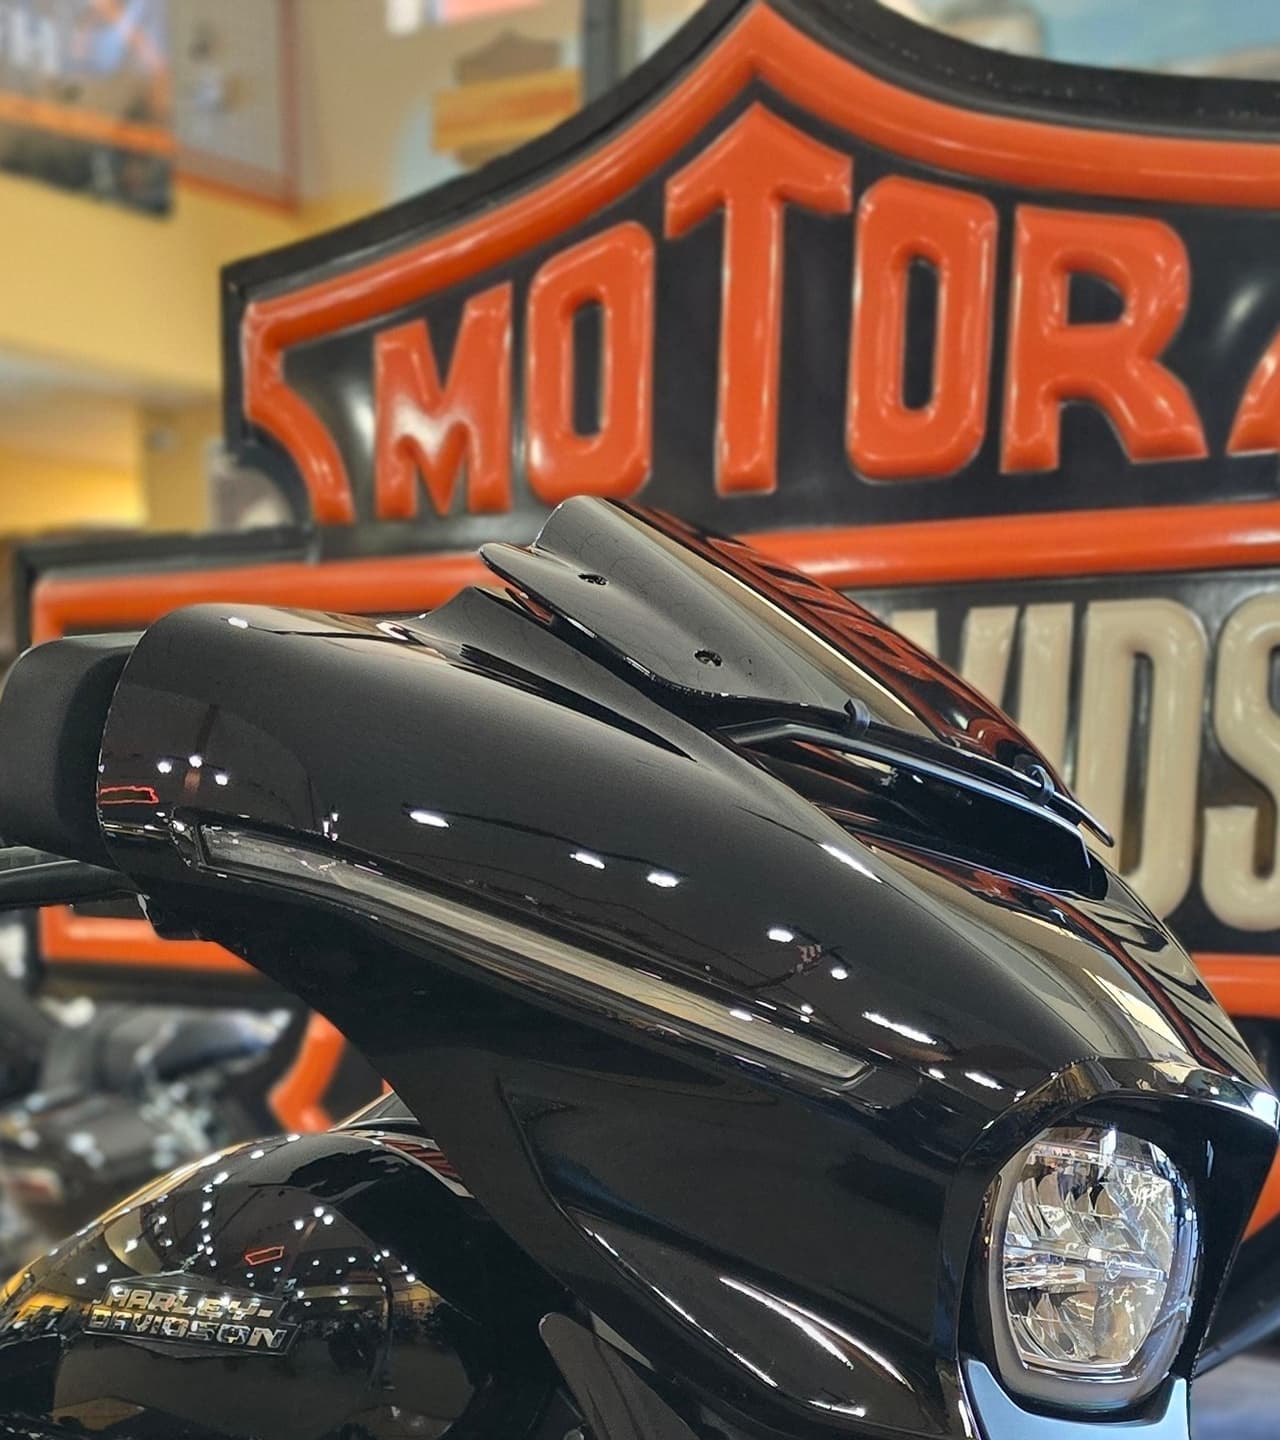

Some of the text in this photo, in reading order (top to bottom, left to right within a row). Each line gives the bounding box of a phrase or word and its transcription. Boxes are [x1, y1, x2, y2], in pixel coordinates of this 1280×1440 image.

[372, 103, 1209, 519] MOTOR
[105, 1286, 274, 1321] HARLEY-
[87, 1307, 288, 1349] DAVIDSON
